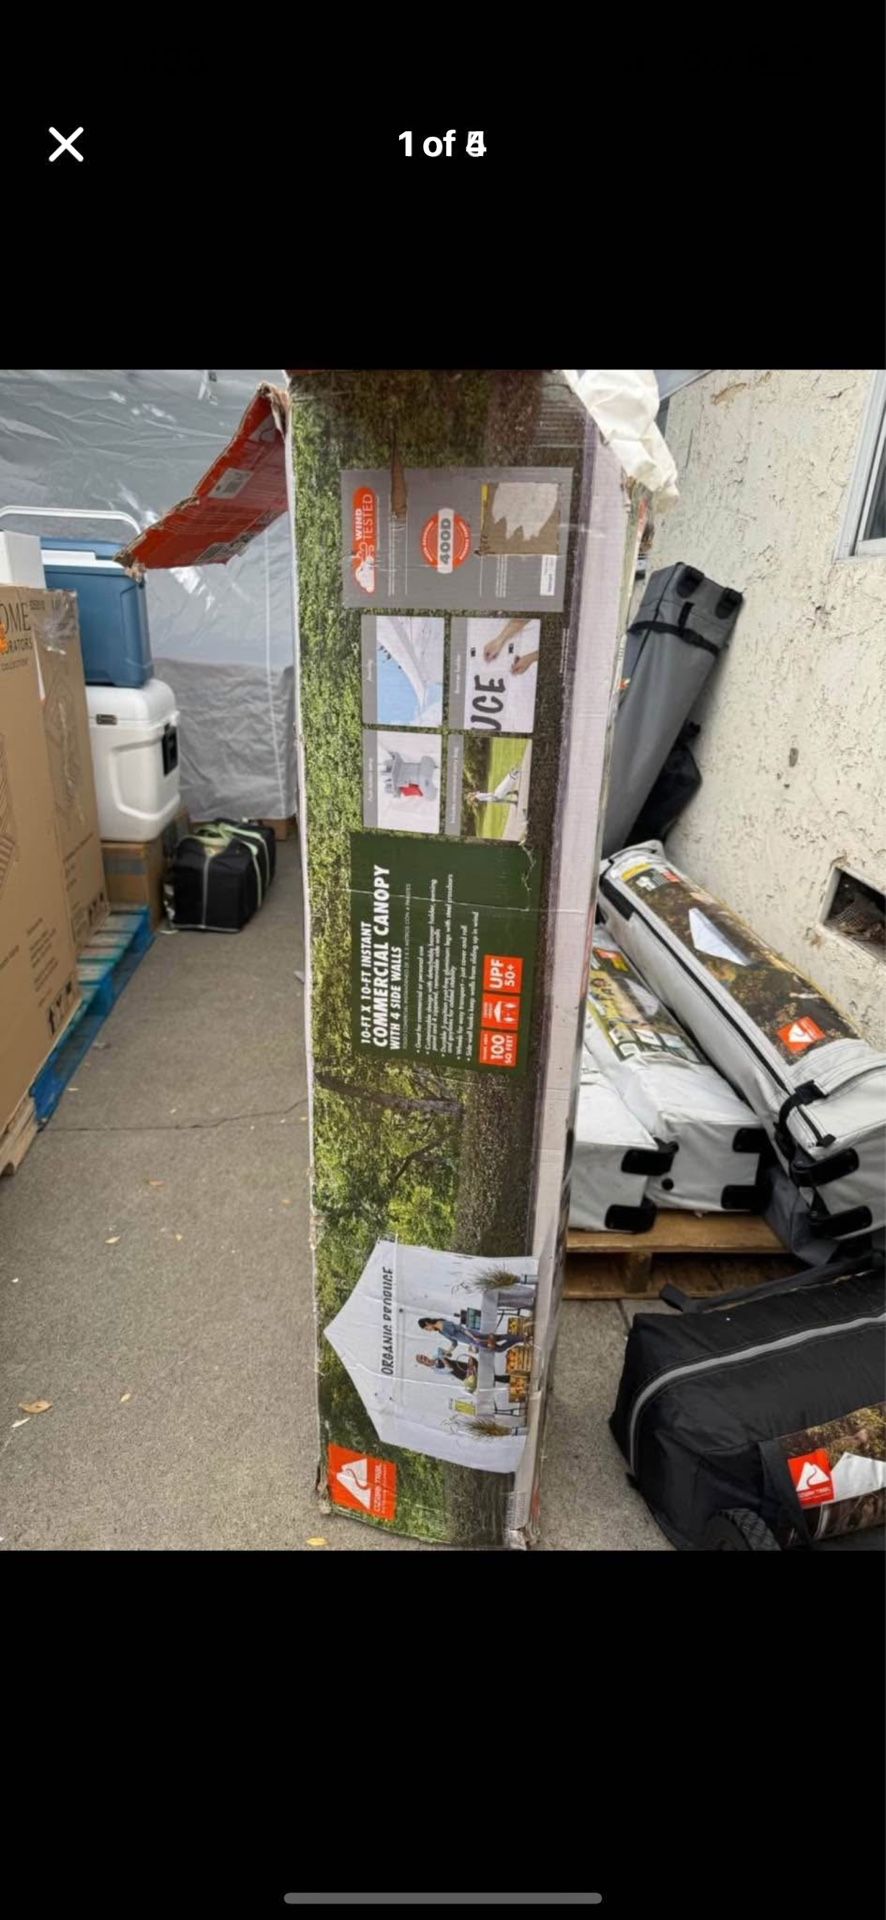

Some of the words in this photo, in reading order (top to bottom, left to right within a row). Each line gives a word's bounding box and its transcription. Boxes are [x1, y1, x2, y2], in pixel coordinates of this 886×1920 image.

[362, 494, 373, 540] TESTED
[440, 518, 451, 565] 400D
[470, 675, 506, 731] UCE
[373, 864, 390, 936] CANOPY
[360, 921, 372, 968] INSTANT
[390, 946, 402, 982] WALLS
[490, 958, 504, 988] UPF
[505, 964, 516, 987] 50+
[360, 970, 371, 1000] 10-FT
[372, 942, 389, 1048] COMMERCIAL
[390, 985, 401, 1009] SIDE
[360, 1004, 371, 1012] X
[390, 1012, 400, 1020] 4
[360, 1015, 371, 1044] 10-FT
[390, 1023, 400, 1050] WITH
[490, 1034, 505, 1059] 100
[380, 1325, 394, 1375] ORGANIC
